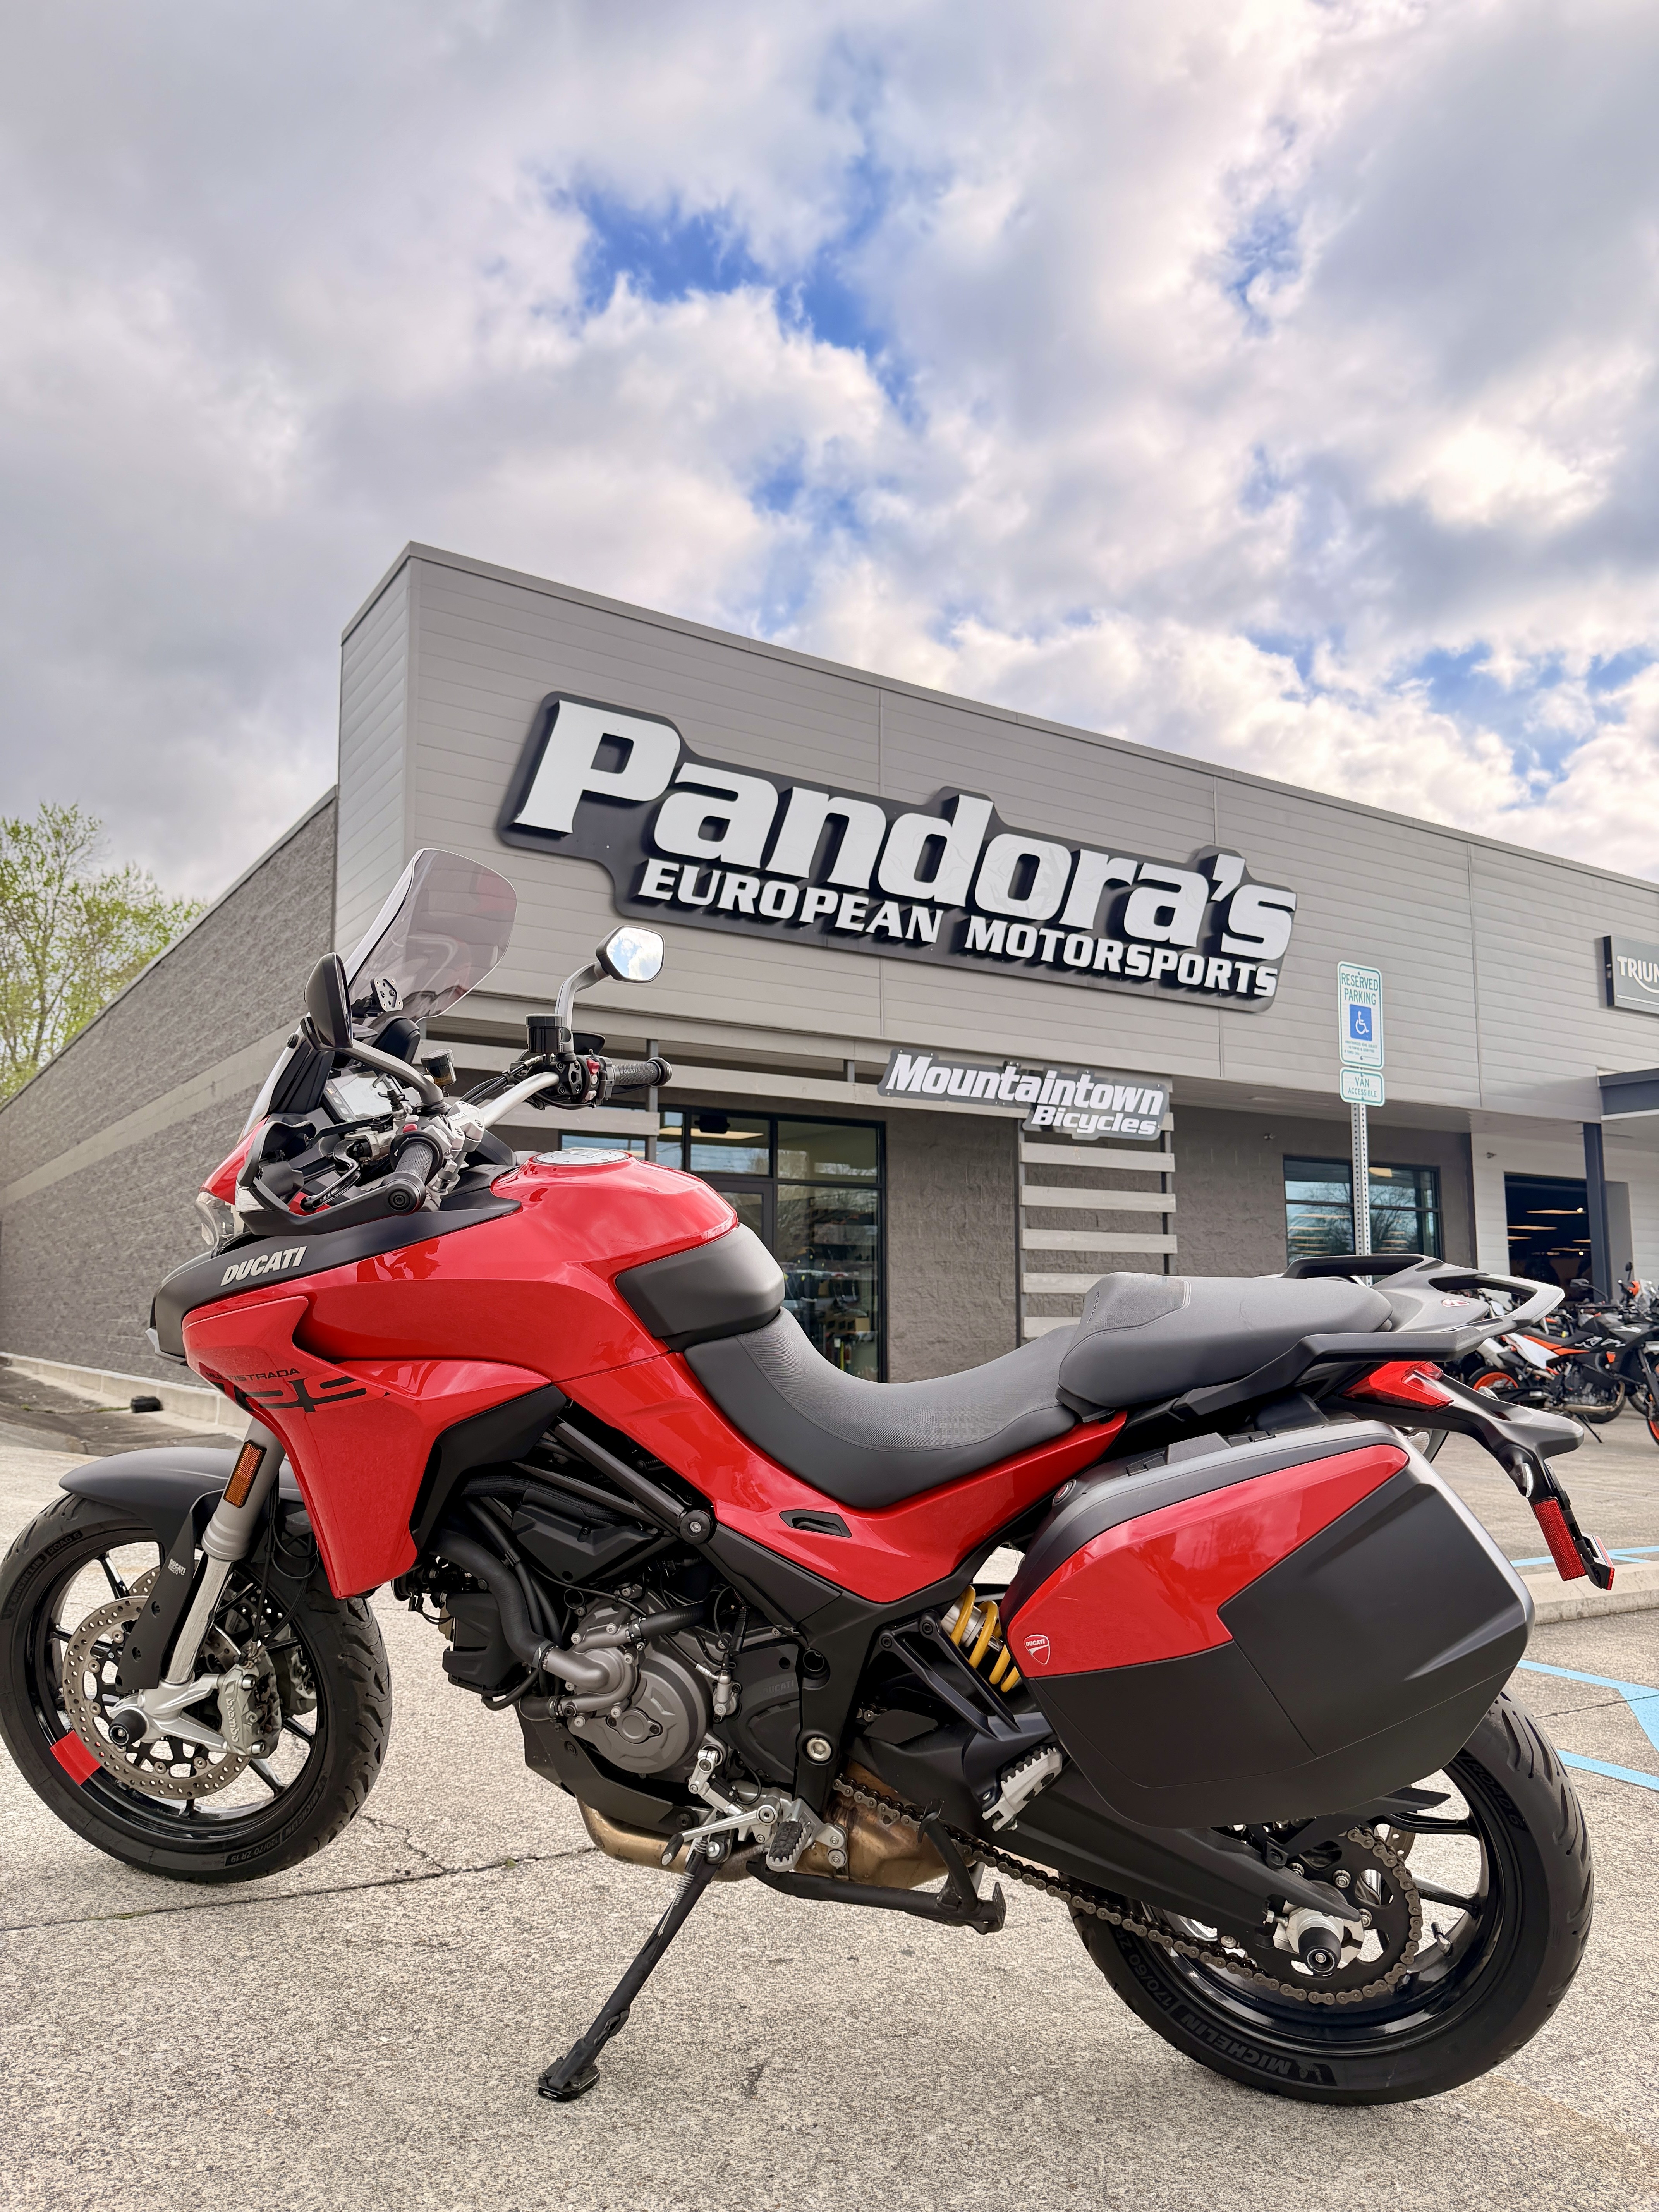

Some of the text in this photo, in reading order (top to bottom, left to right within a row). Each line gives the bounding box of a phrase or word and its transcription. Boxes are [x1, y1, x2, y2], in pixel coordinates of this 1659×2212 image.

[514, 699, 1297, 960] Pandora's
[638, 858, 1278, 997] EUROPEAN MOTORSPORTS
[1341, 972, 1378, 991] RESERVED
[1344, 988, 1376, 1006] PARKING
[885, 1054, 1164, 1116] Mountaintown
[1348, 1087, 1377, 1098] ACCESSIBLE
[1355, 1077, 1370, 1088] VAN
[1030, 1104, 1159, 1135] Bicycles
[220, 1245, 307, 1287] DUCATI
[205, 1367, 300, 1381] MULTISTRADA
[48, 1536, 72, 1554] ROAD
[11, 1558, 43, 1602] MICHELIN
[169, 1558, 186, 1573] DUCATI
[1025, 1638, 1045, 1647] DUCATI
[763, 1679, 794, 1693] DUCATI
[225, 1698, 240, 1743] brembo
[1467, 1762, 1513, 1809] ROAD
[285, 1791, 318, 1836] MICHELIN
[254, 1837, 278, 1855] 120/70
[1128, 1954, 1173, 2006] 170/60
[1180, 2014, 1292, 2075] MICHELIN
